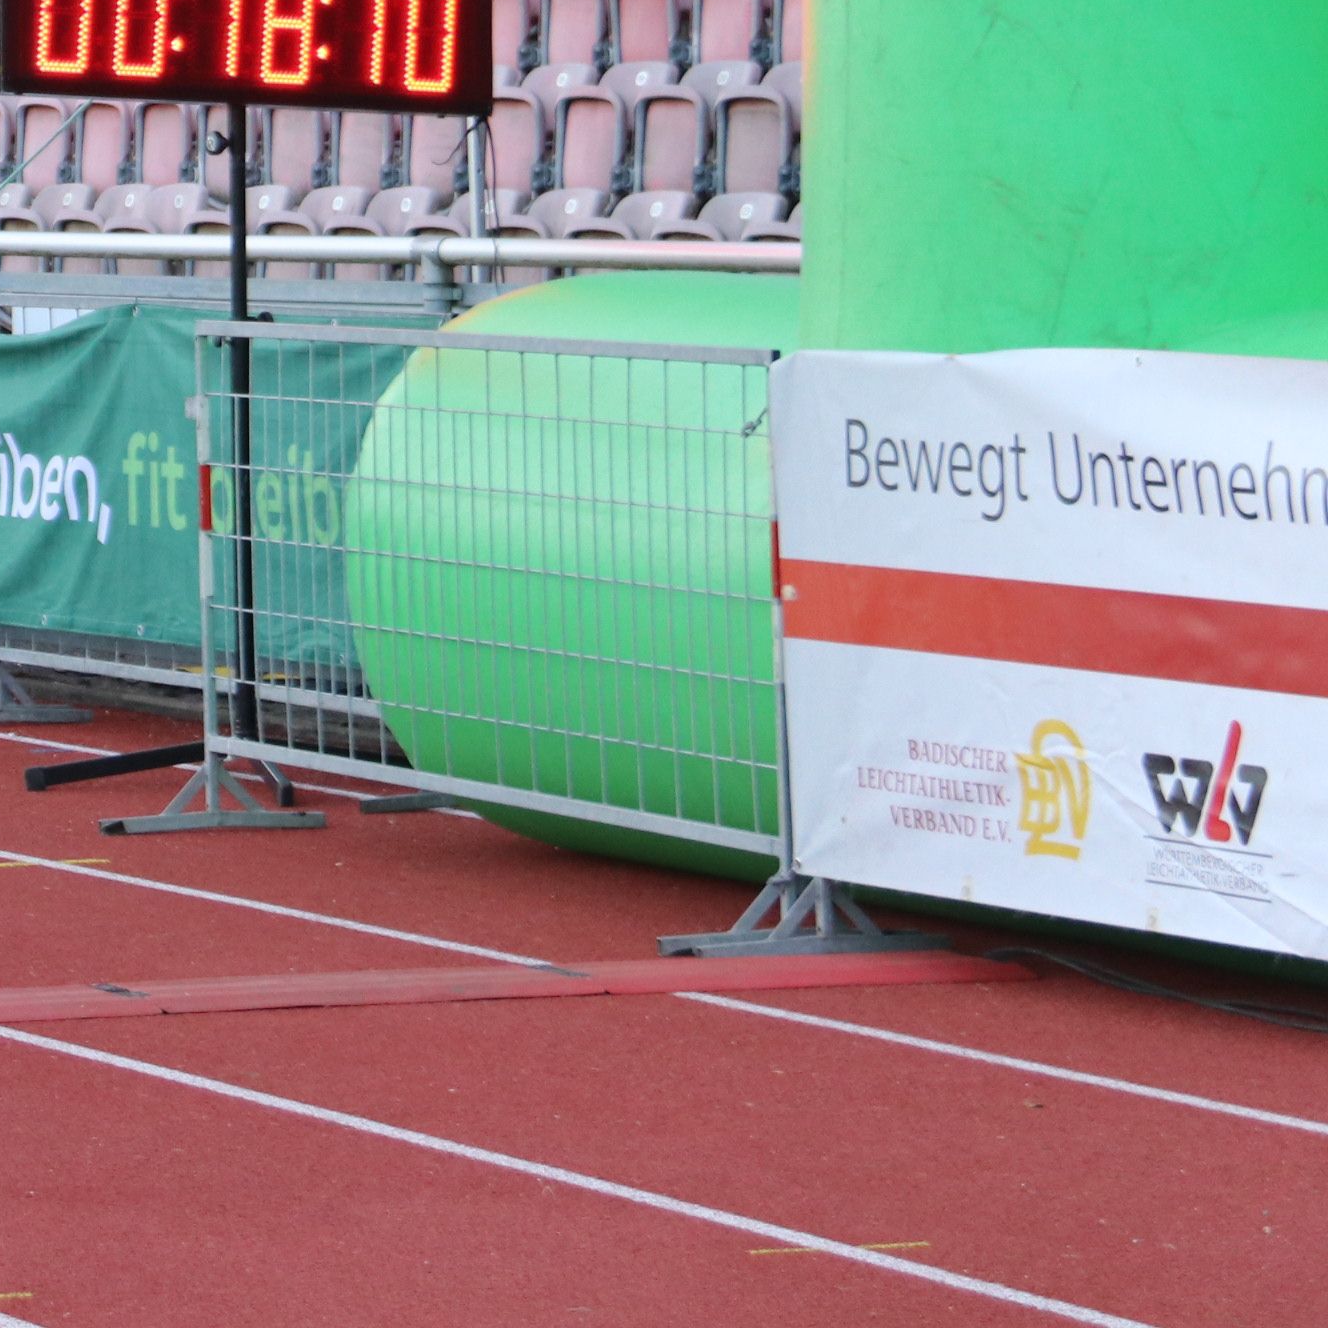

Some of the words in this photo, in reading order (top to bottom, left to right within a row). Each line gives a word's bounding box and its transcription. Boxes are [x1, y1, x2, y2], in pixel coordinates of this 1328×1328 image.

[122, 432, 187, 531] fit
[845, 417, 1029, 522] Bewegt
[907, 739, 1008, 773] BADISCHER
[857, 766, 1012, 807] LEICHTATHLETIK-
[890, 805, 976, 838] VERBAND
[983, 817, 1012, 844] E.V.
